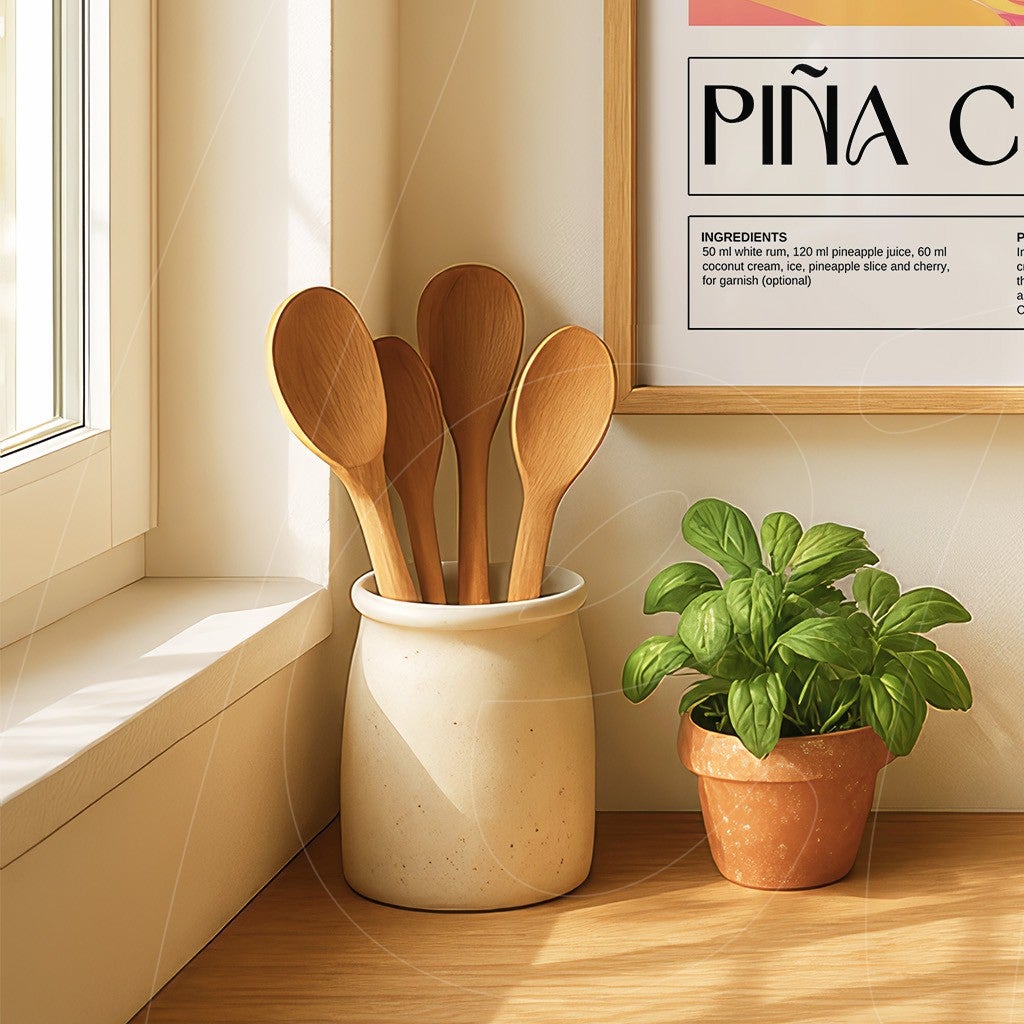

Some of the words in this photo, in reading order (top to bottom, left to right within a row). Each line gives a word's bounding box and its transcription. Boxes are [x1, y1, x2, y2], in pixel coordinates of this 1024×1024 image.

[705, 64, 908, 165] PIÑA
[701, 231, 788, 243] INGREDIENTS
[702, 246, 717, 257] 50
[718, 246, 732, 257] ml
[734, 245, 763, 257] white
[765, 248, 790, 258] rum,
[793, 246, 814, 257] 120
[815, 246, 829, 257] ml
[831, 246, 884, 260] pineapple
[885, 246, 915, 260] juice,
[917, 246, 932, 258] 60
[934, 246, 947, 257] ml
[702, 261, 745, 272] coconut
[746, 262, 784, 273] cream,
[786, 260, 806, 273] ice,
[808, 260, 861, 274] pineapple
[863, 260, 888, 272] slice
[890, 260, 911, 272] and
[913, 260, 950, 274] cherry,
[702, 274, 717, 286] for
[719, 274, 759, 289] garnish
[761, 274, 812, 288] (optional)
